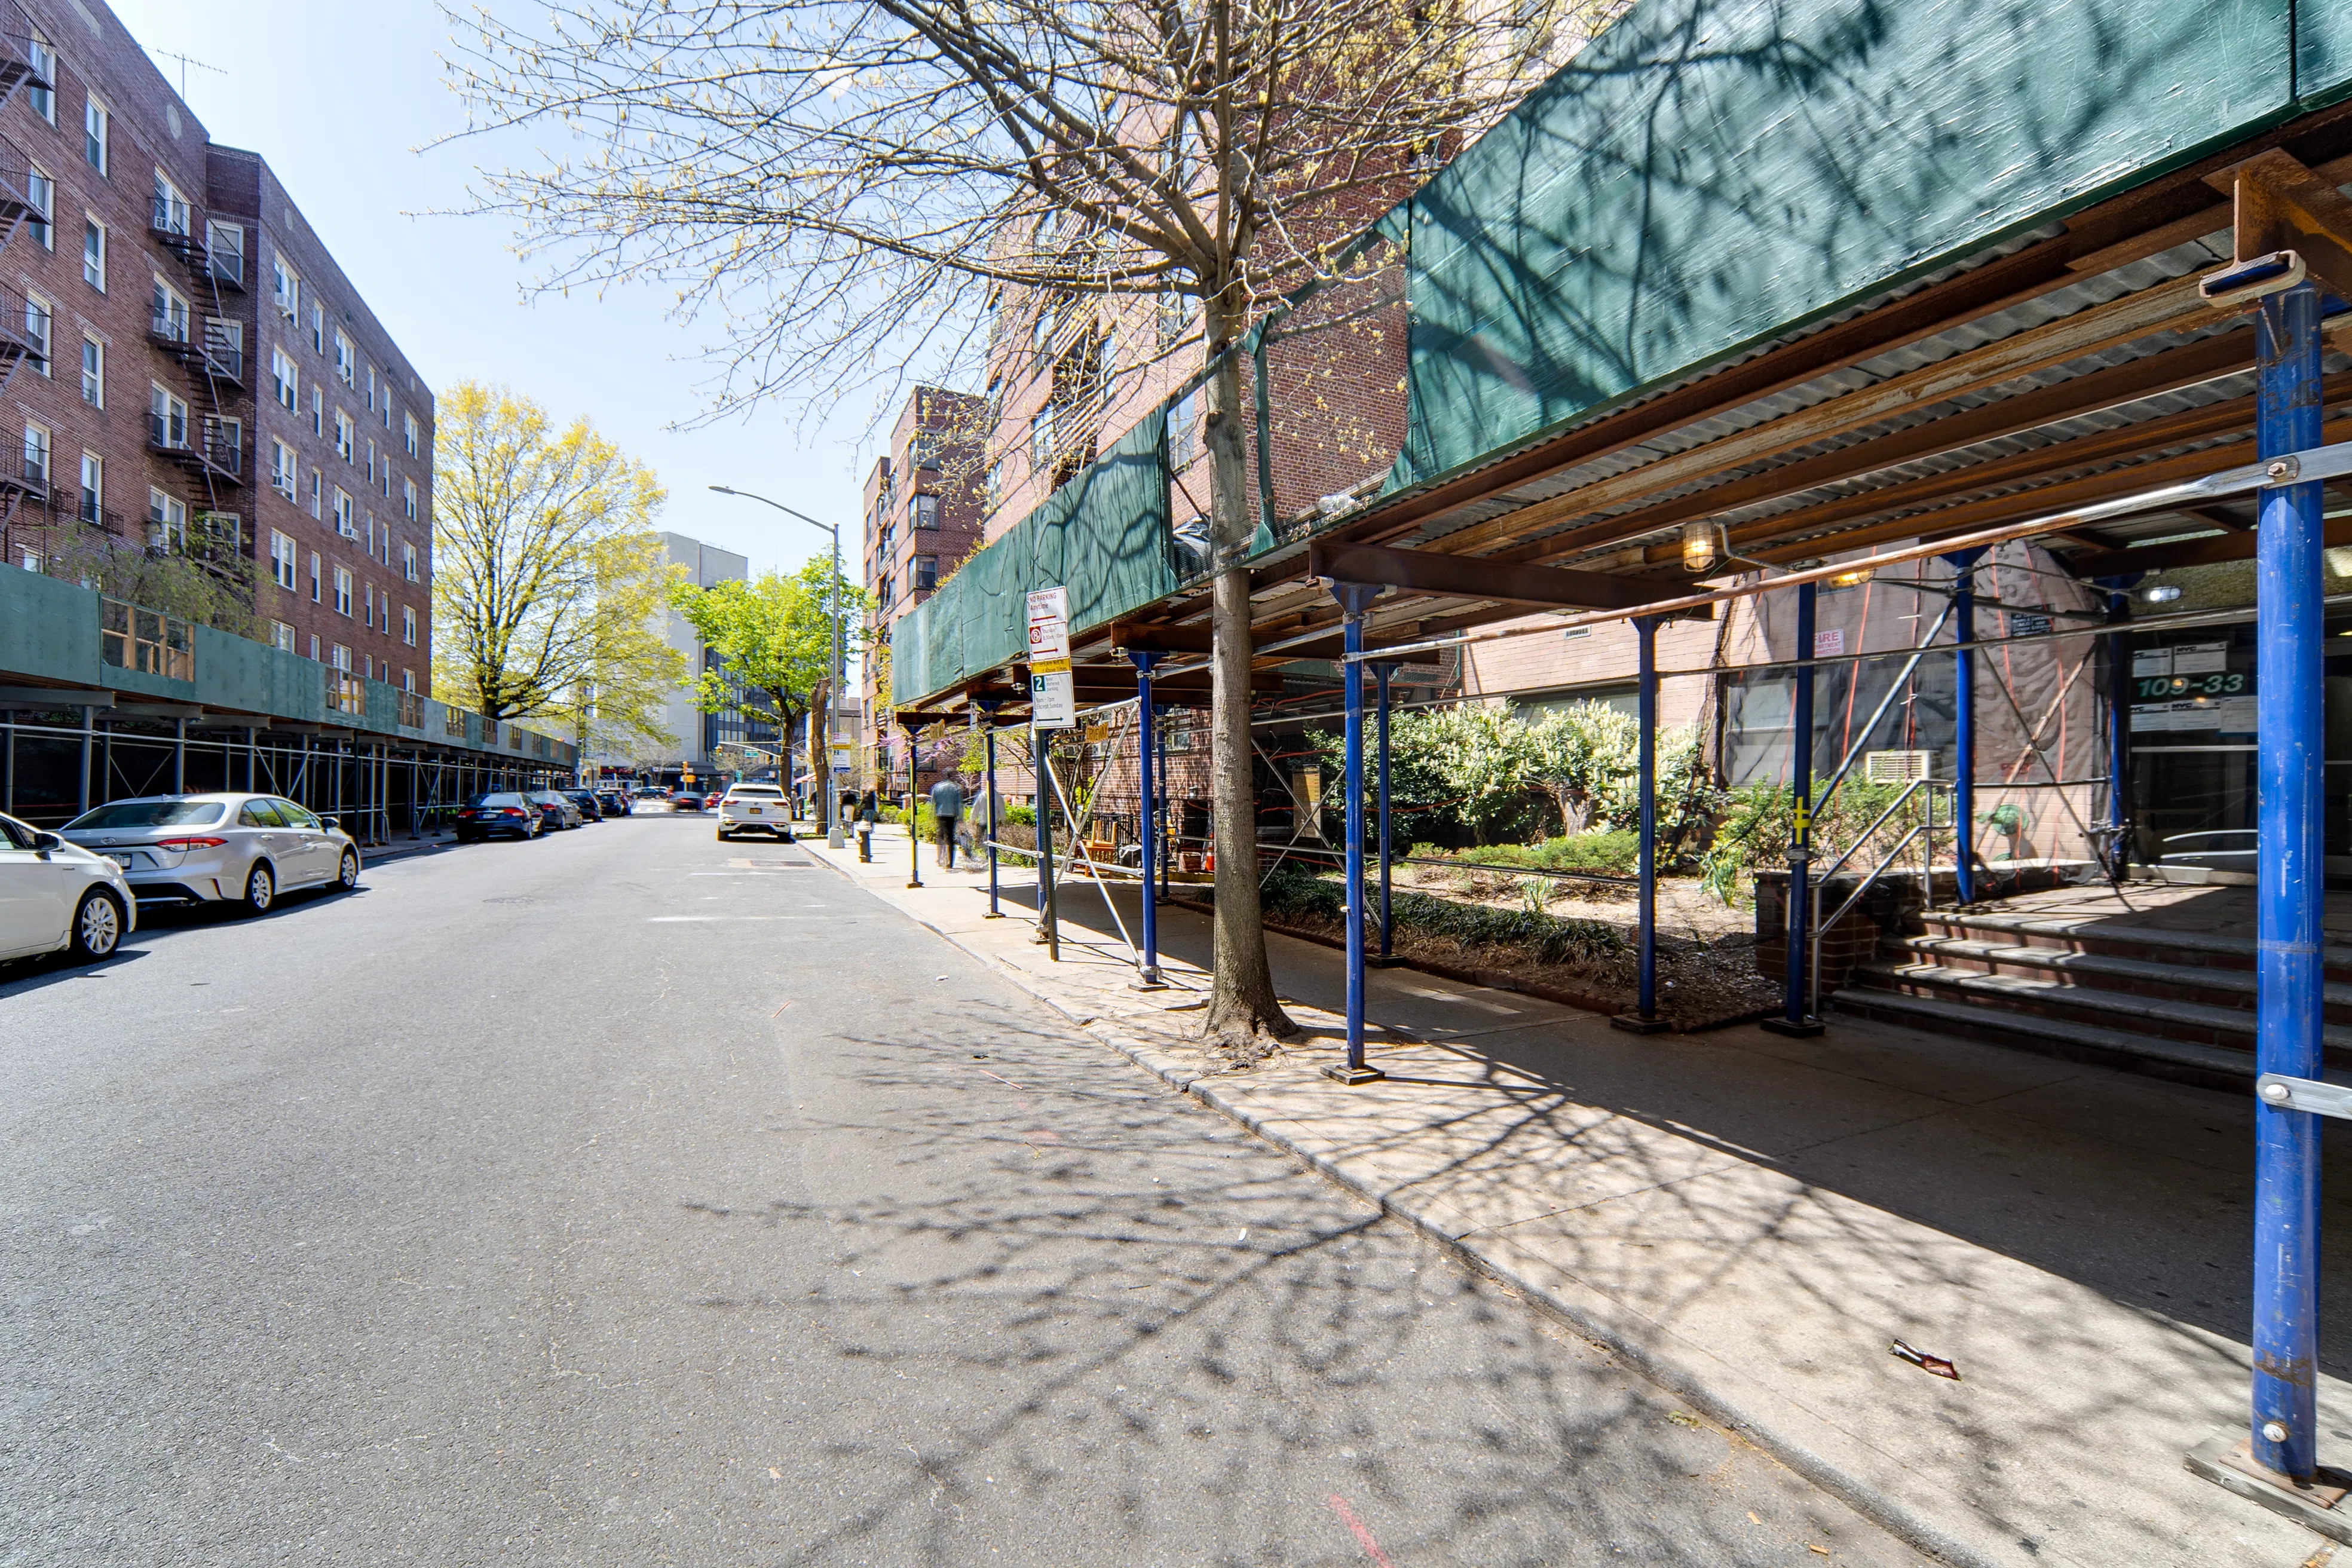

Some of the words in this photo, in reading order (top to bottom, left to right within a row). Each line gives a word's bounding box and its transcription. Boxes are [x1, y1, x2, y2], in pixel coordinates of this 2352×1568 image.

[1037, 592, 1056, 601] PARKING
[1815, 632, 1839, 643] IRE
[1816, 641, 1841, 650] PARTMENT
[1036, 676, 1043, 690] 2
[2138, 674, 2244, 696] 109-33
